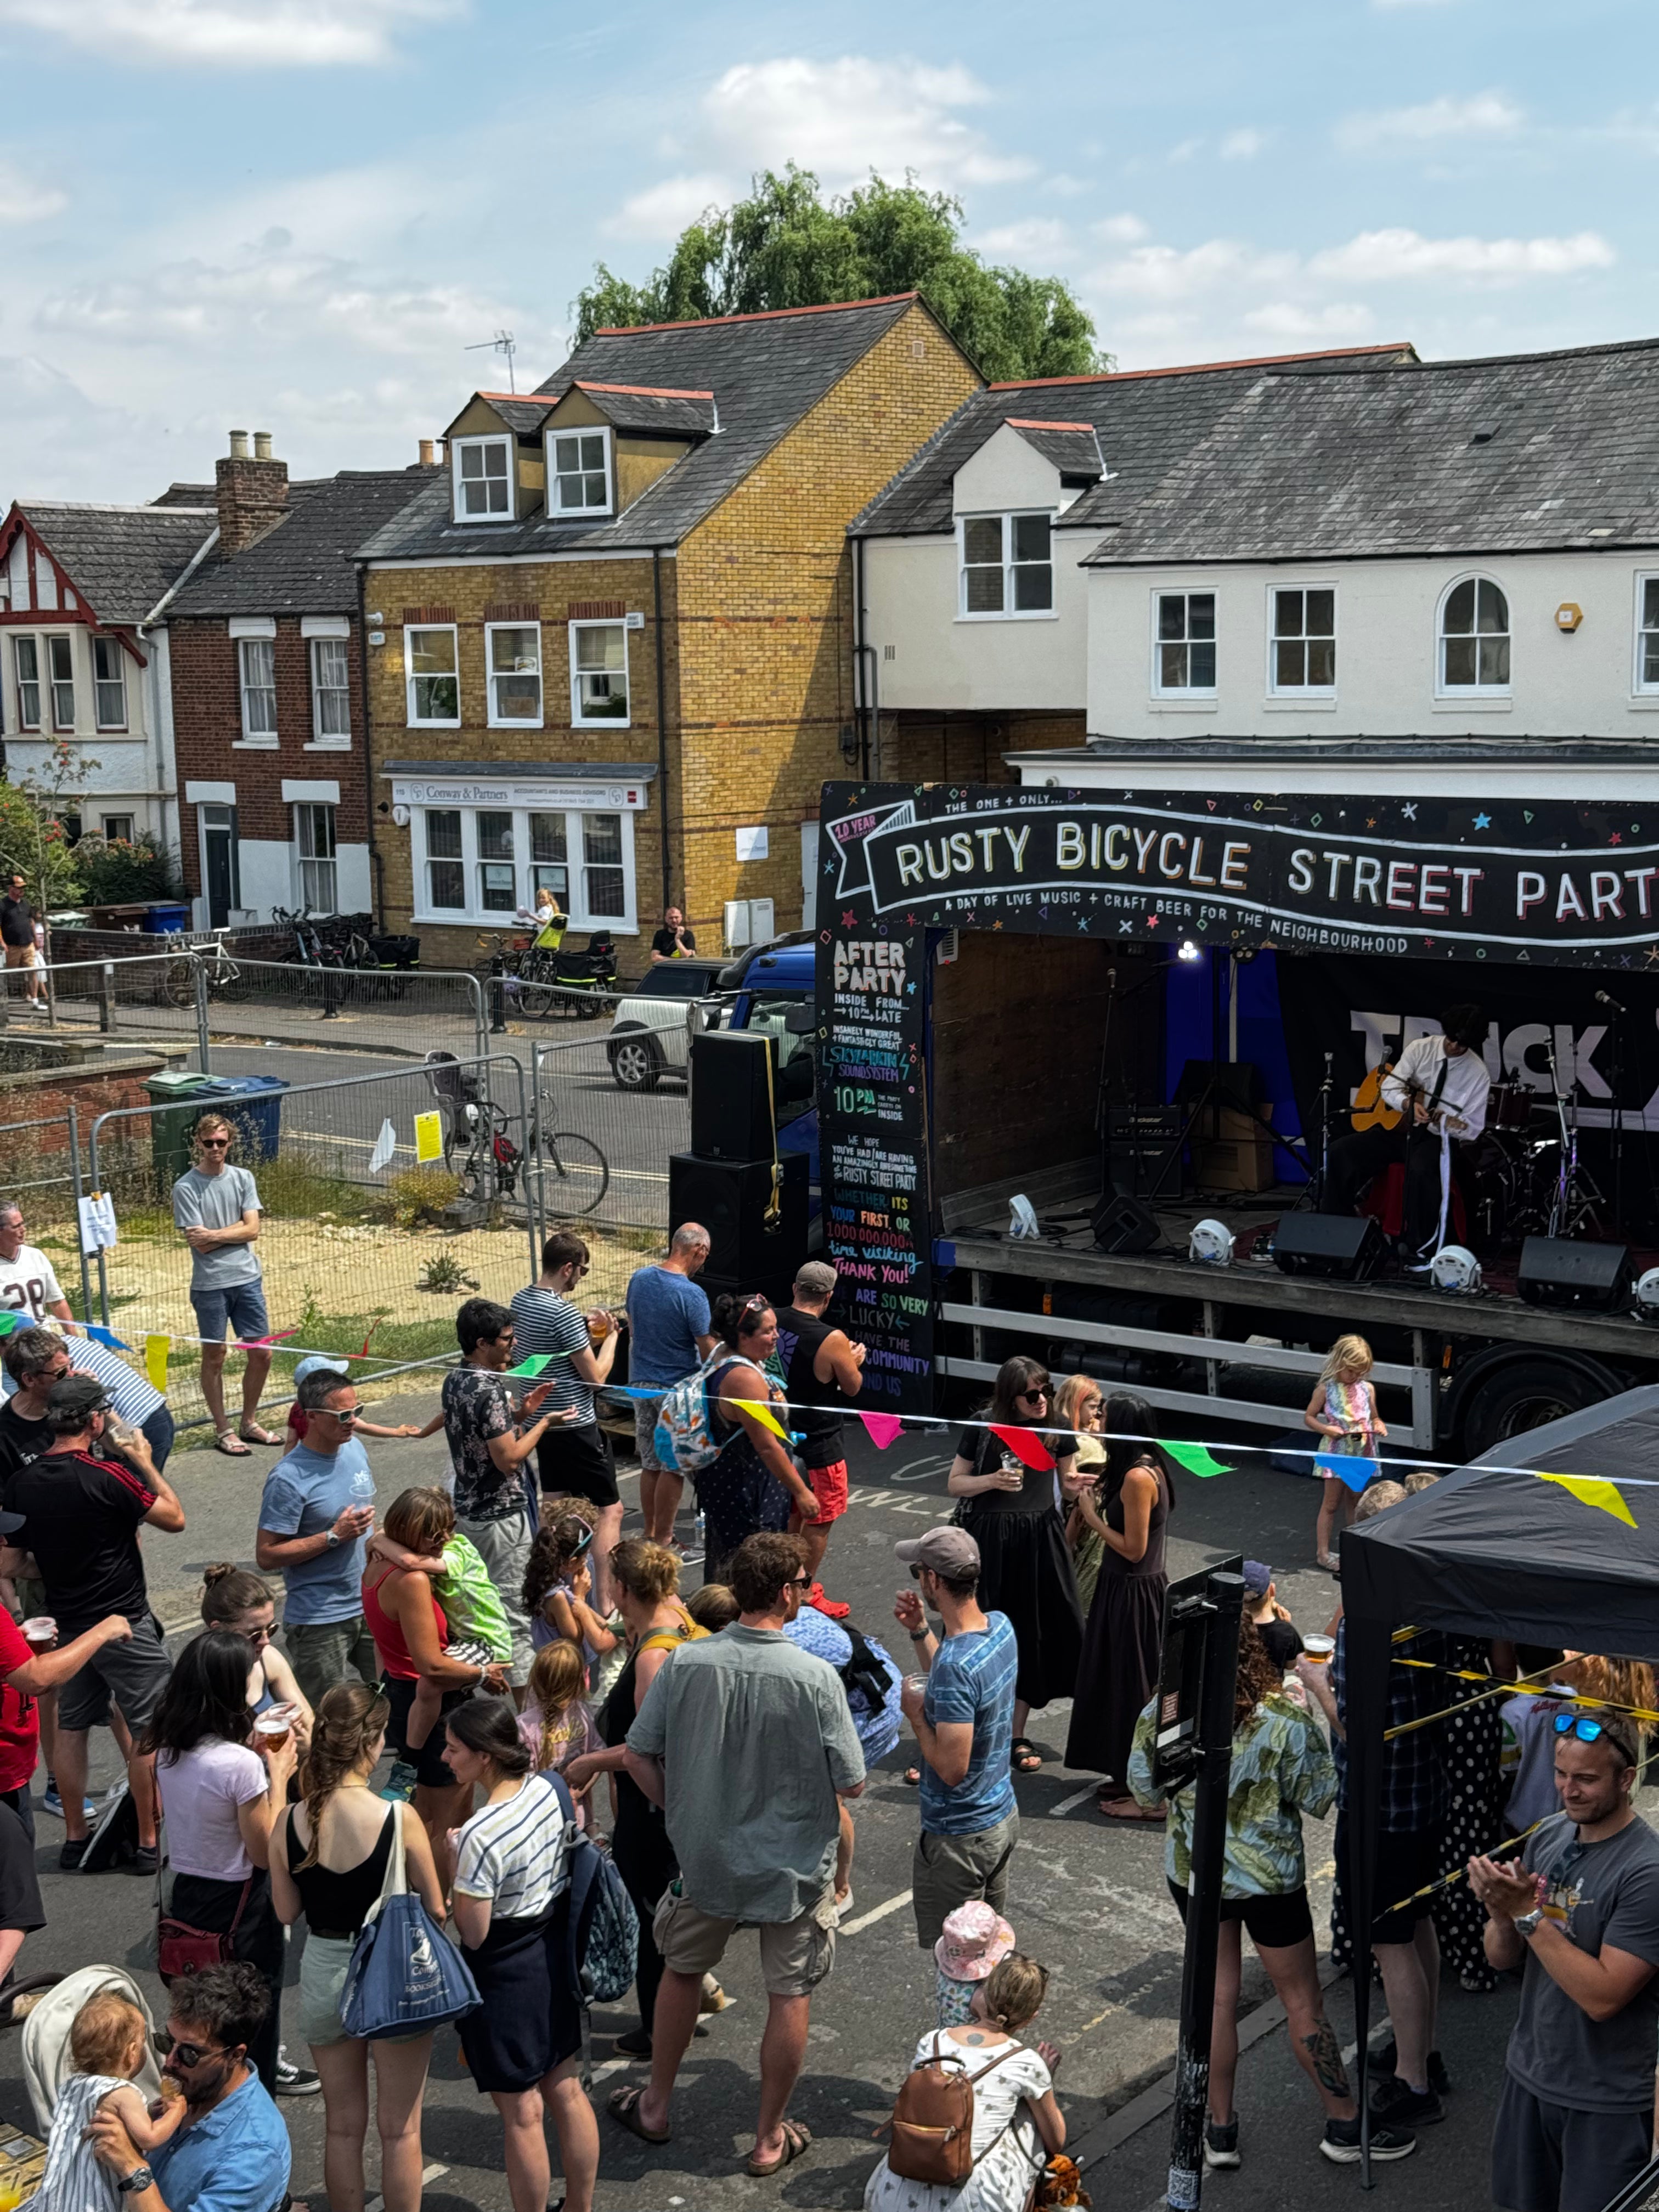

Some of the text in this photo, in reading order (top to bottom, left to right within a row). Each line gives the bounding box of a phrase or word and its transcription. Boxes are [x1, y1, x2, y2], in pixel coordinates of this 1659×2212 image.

[426, 786, 507, 800] Conway & Partners
[945, 803, 967, 814] THE
[976, 798, 1000, 810] ONE
[1005, 797, 1013, 806] +
[834, 822, 849, 840] 10
[850, 815, 877, 834] YEAR
[895, 821, 1659, 924] RUSTY BICYCLE STREET PART
[945, 891, 1408, 953] A DAY OF LIVE MUSIC + CRAFT BEER FOR THE NEIGHBOURHOOD
[833, 940, 906, 967] AFTER
[833, 966, 906, 996] PARTY
[834, 992, 866, 1007] INSIDE
[876, 1008, 902, 1024] LATE
[833, 1024, 903, 1041] INSANELY WONDERFUL
[877, 1038, 902, 1052] GREAT
[878, 1109, 904, 1121] INSIDE
[848, 1134, 880, 1148] WE HOPE
[832, 1144, 854, 1155] YOU'VE
[888, 1153, 915, 1165] HAVING
[832, 1155, 842, 1164] AN
[843, 1156, 878, 1169] AMAZINGLY
[843, 1166, 917, 1191] RUSTY STREET PARTY
[833, 1187, 909, 1211] WHETHER ITS
[830, 1205, 855, 1222] YOUR
[895, 1216, 911, 1232] OR
[828, 1240, 858, 1257] time
[832, 1257, 910, 1284] THANK YOU!
[855, 1288, 878, 1306] ARE
[881, 1293, 898, 1310] SO
[899, 1295, 929, 1317] VERY
[850, 1305, 895, 1330] LUCKY
[855, 1330, 883, 1347] HAVE
[888, 1335, 910, 1353] THE
[865, 1348, 930, 1376] COMMUNITY
[886, 1376, 902, 1397] US
